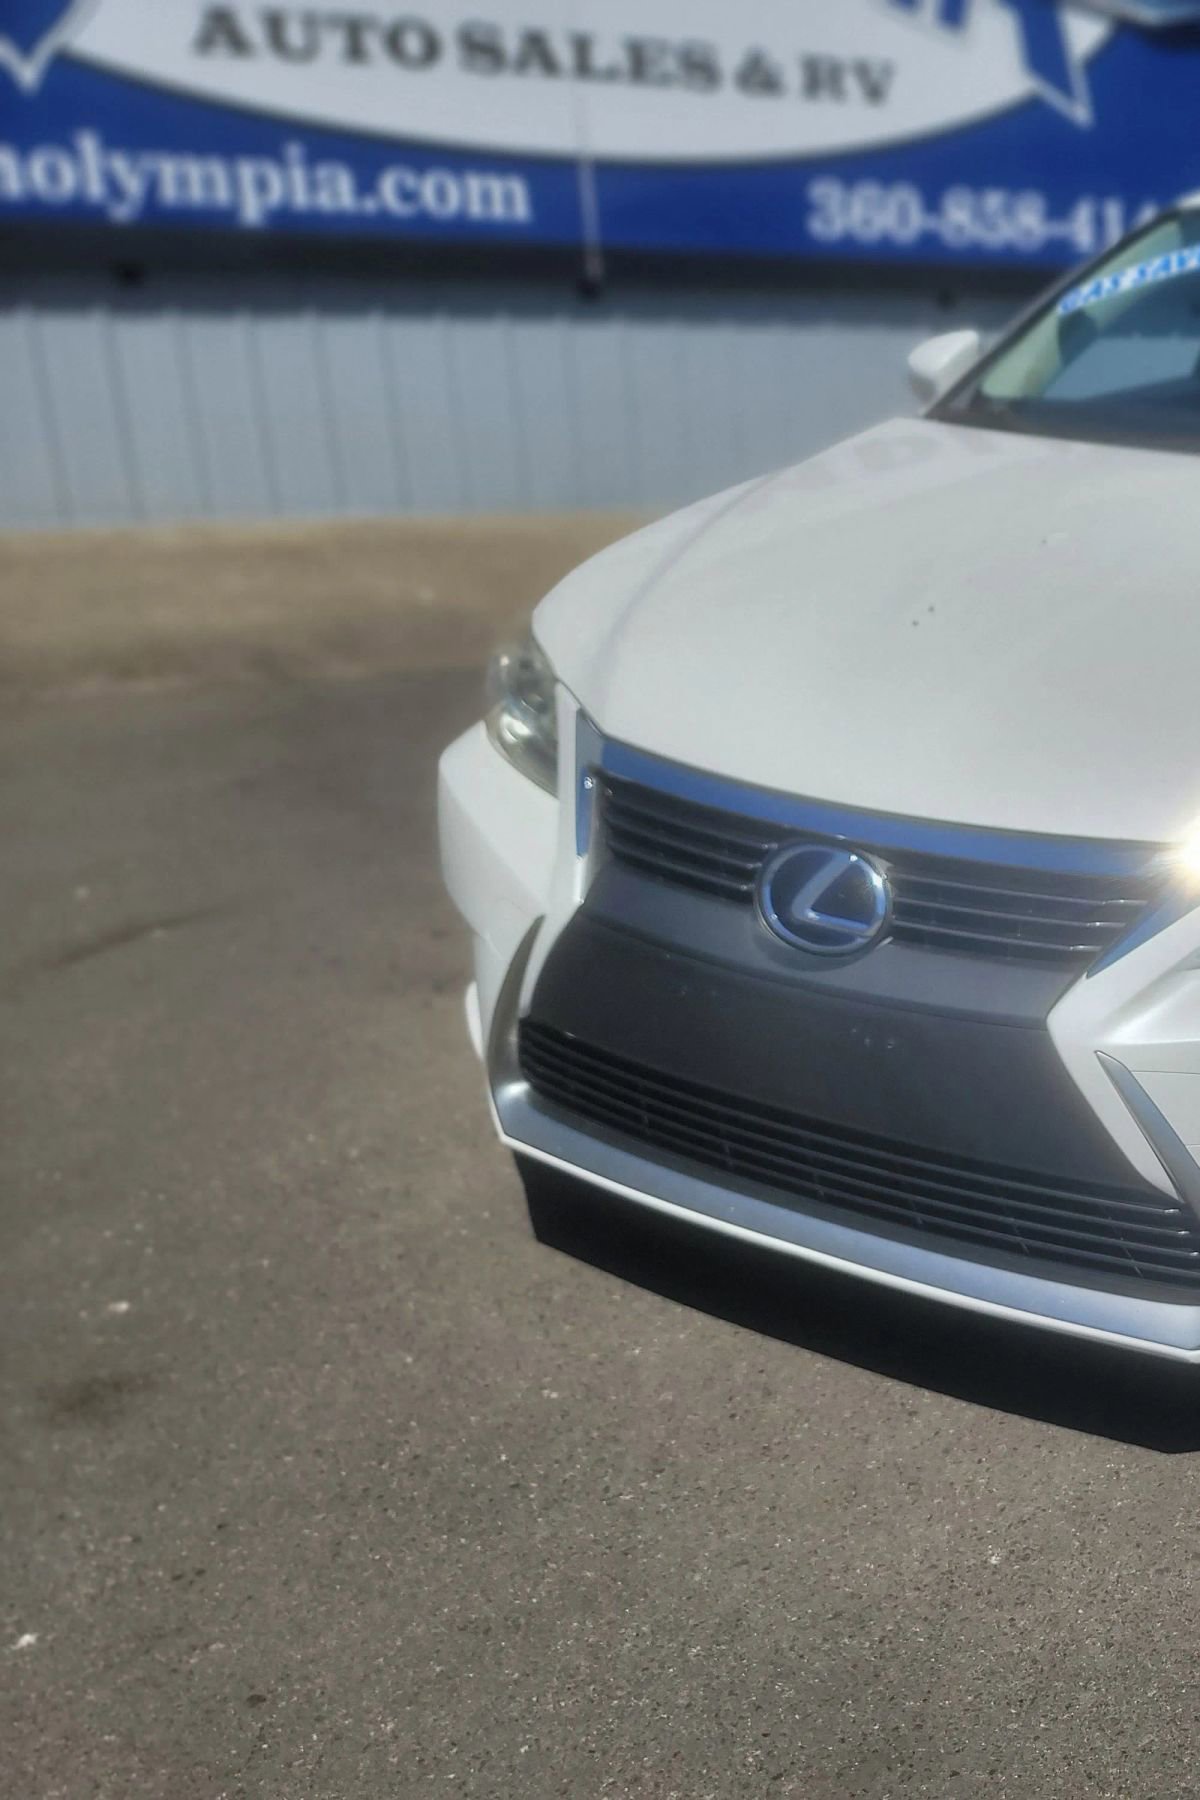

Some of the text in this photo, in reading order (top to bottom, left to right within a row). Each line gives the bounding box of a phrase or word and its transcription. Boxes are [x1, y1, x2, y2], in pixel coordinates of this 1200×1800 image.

[193, 5, 898, 105] AUTO SALES & RV
